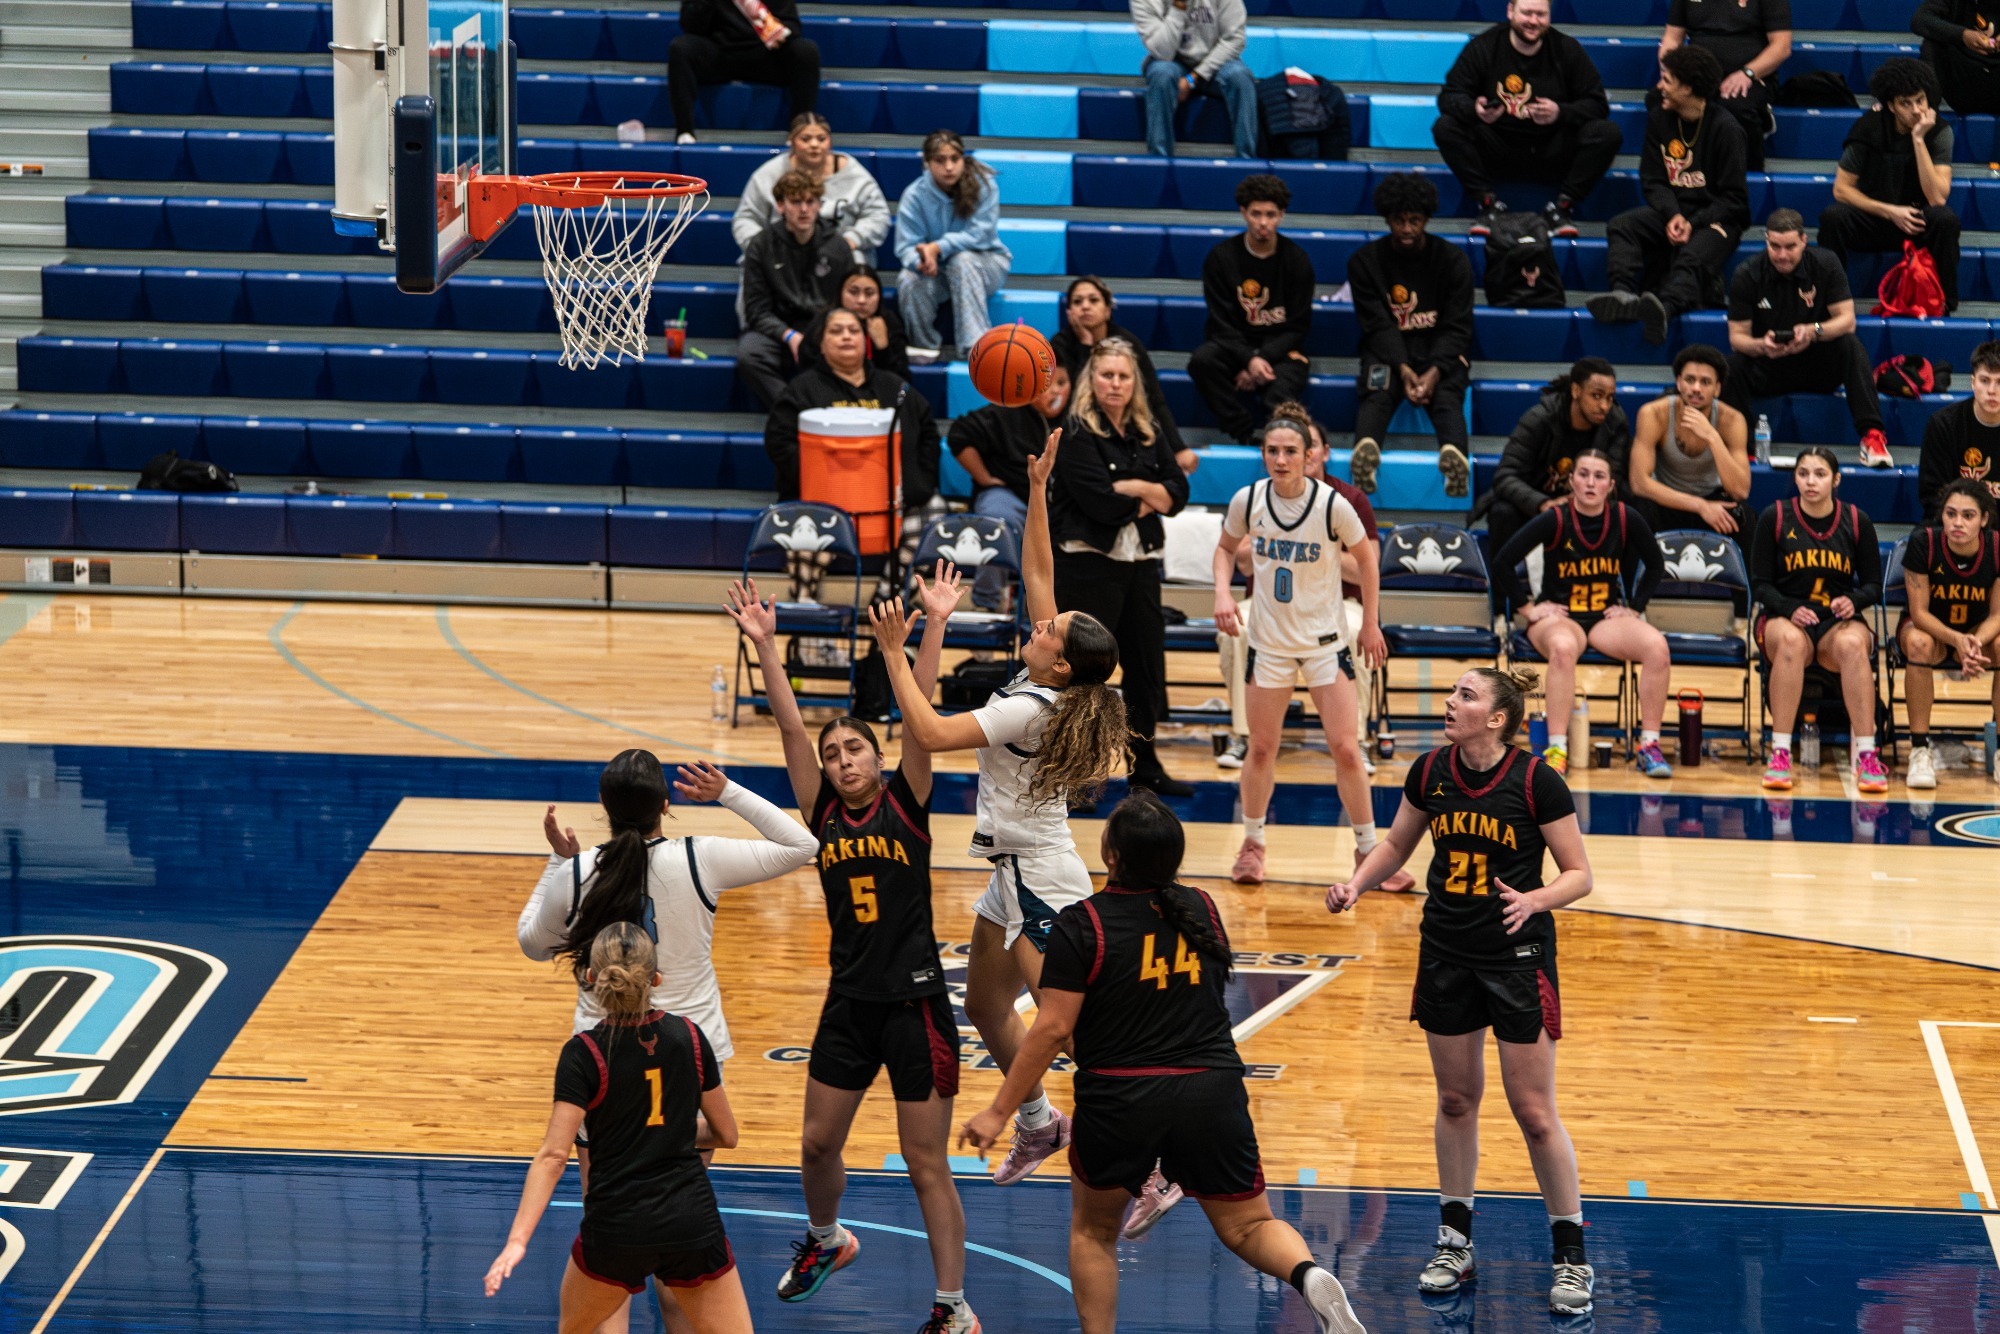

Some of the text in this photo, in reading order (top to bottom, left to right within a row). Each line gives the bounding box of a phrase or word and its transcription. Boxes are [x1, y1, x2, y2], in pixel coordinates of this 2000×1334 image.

[1255, 536, 1321, 563] HAWKS
[1783, 548, 1852, 575] YAKIMA
[1557, 556, 1620, 578] YAKIMA
[1274, 566, 1293, 604] 0
[1569, 582, 1609, 612] 22
[1809, 577, 1831, 607] 4
[1930, 583, 1986, 602] AKIM
[1430, 811, 1518, 851] YAKIMA
[1445, 850, 1490, 897] 21
[848, 873, 880, 925] 5
[1139, 932, 1202, 991] 44
[644, 1067, 665, 1127] 1
